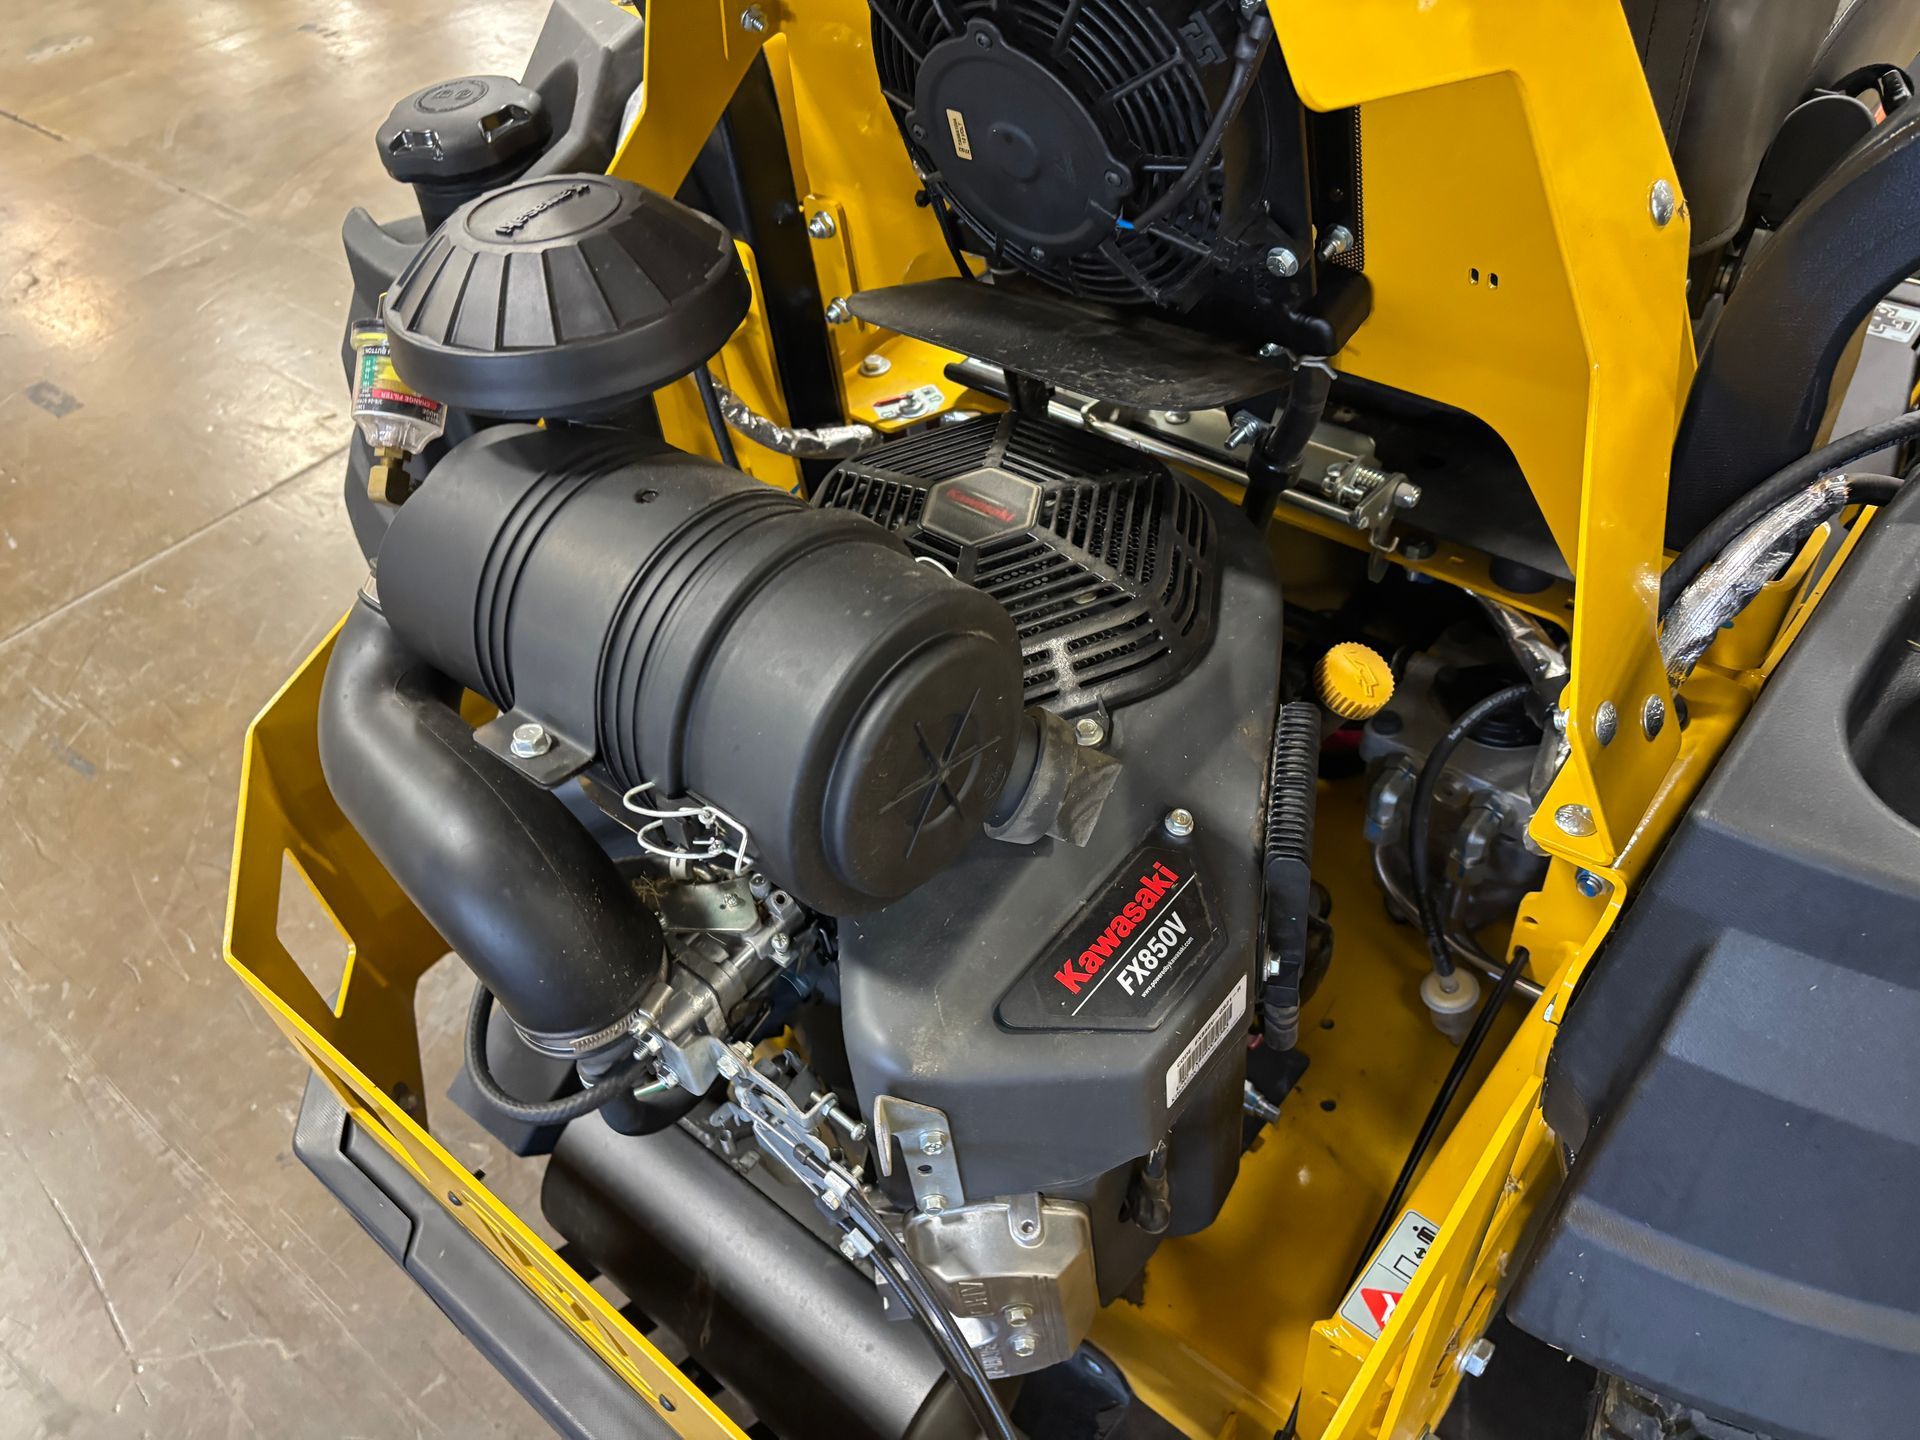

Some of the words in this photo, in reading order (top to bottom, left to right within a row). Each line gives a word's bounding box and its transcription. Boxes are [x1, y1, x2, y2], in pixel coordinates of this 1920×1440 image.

[380, 391, 403, 401] FILTER
[405, 395, 431, 408] CHANGE
[1054, 861, 1179, 995] Kawasaki
[1116, 911, 1187, 996] FX850V
[1141, 936, 1194, 998] www.poweredbykawasaki.com
[1177, 1047, 1191, 1068] CODE
